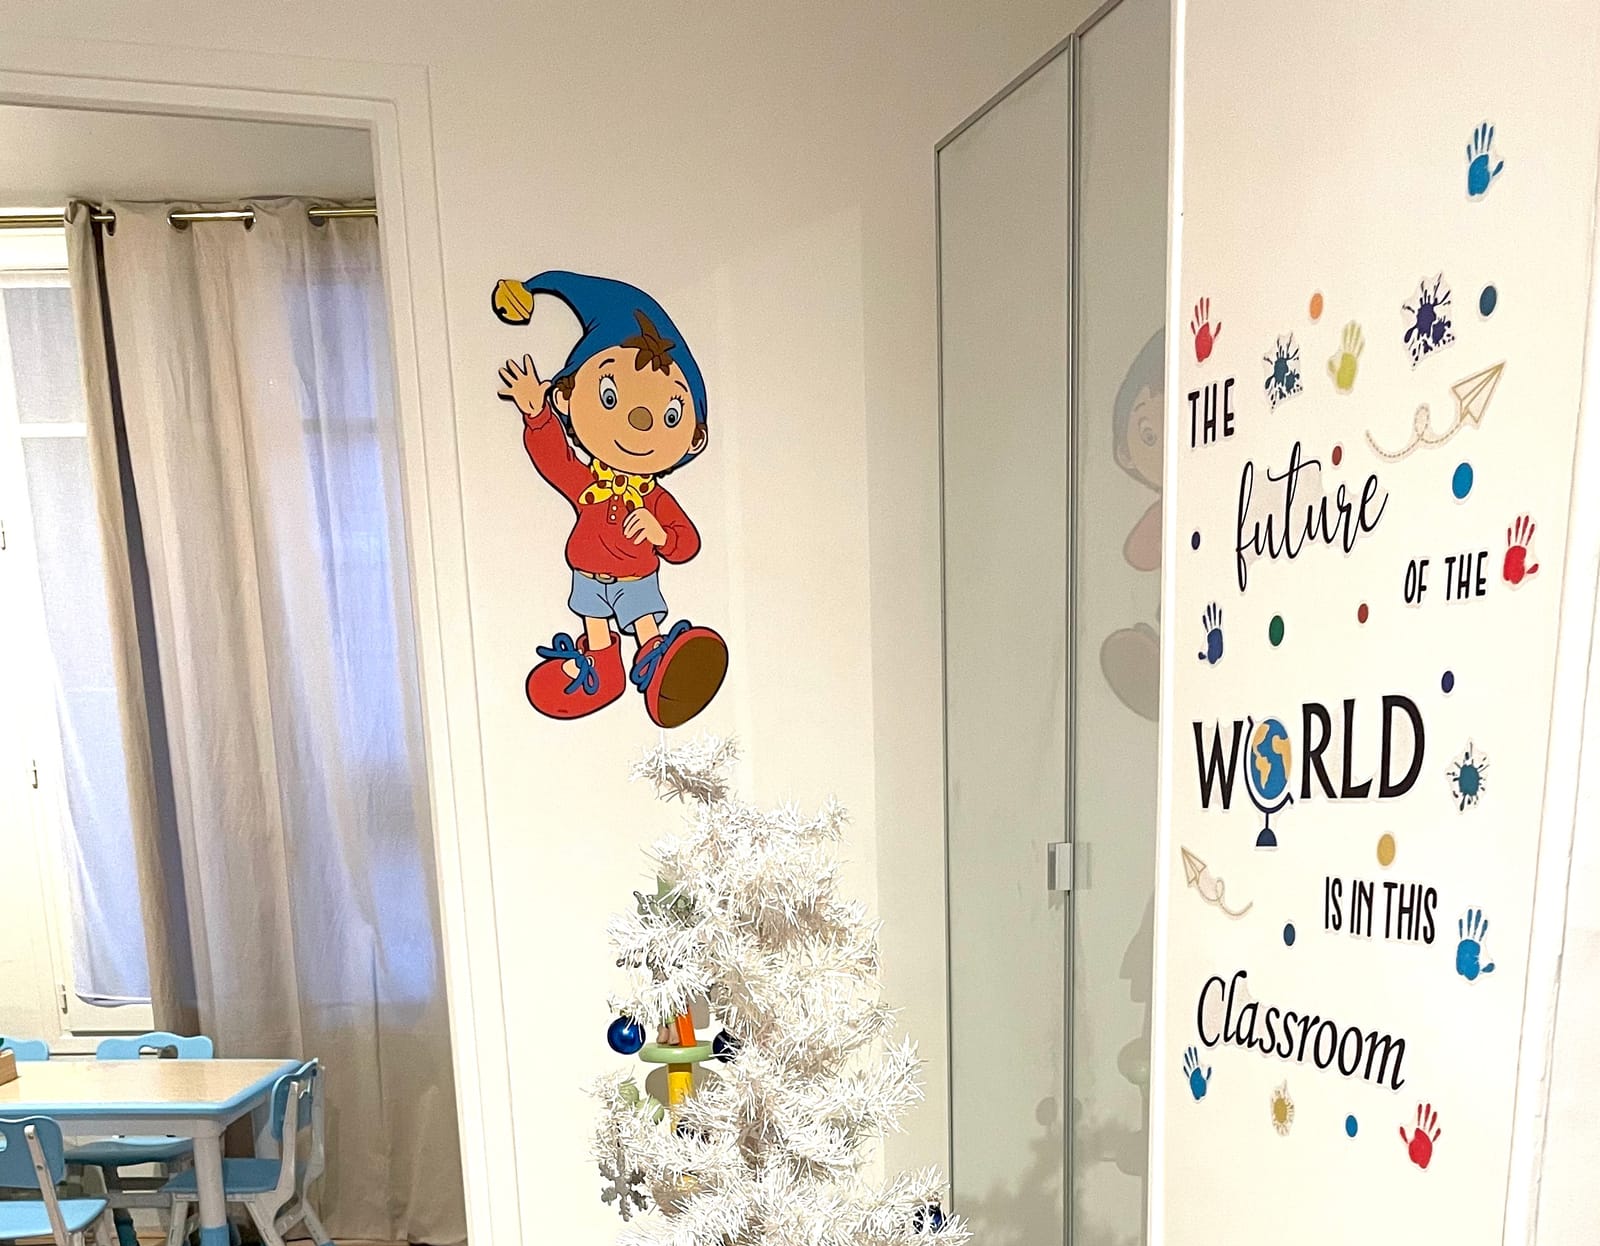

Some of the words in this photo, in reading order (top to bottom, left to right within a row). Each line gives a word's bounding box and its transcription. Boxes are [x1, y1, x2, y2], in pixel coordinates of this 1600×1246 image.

[1188, 377, 1235, 448] THE
[1236, 441, 1389, 592] future
[1404, 559, 1429, 603] OF
[1444, 551, 1488, 600] THE
[1324, 876, 1342, 931] IS
[1350, 879, 1374, 937] IN
[1383, 881, 1437, 944] THIS
[1197, 970, 1406, 1091] Classroom
